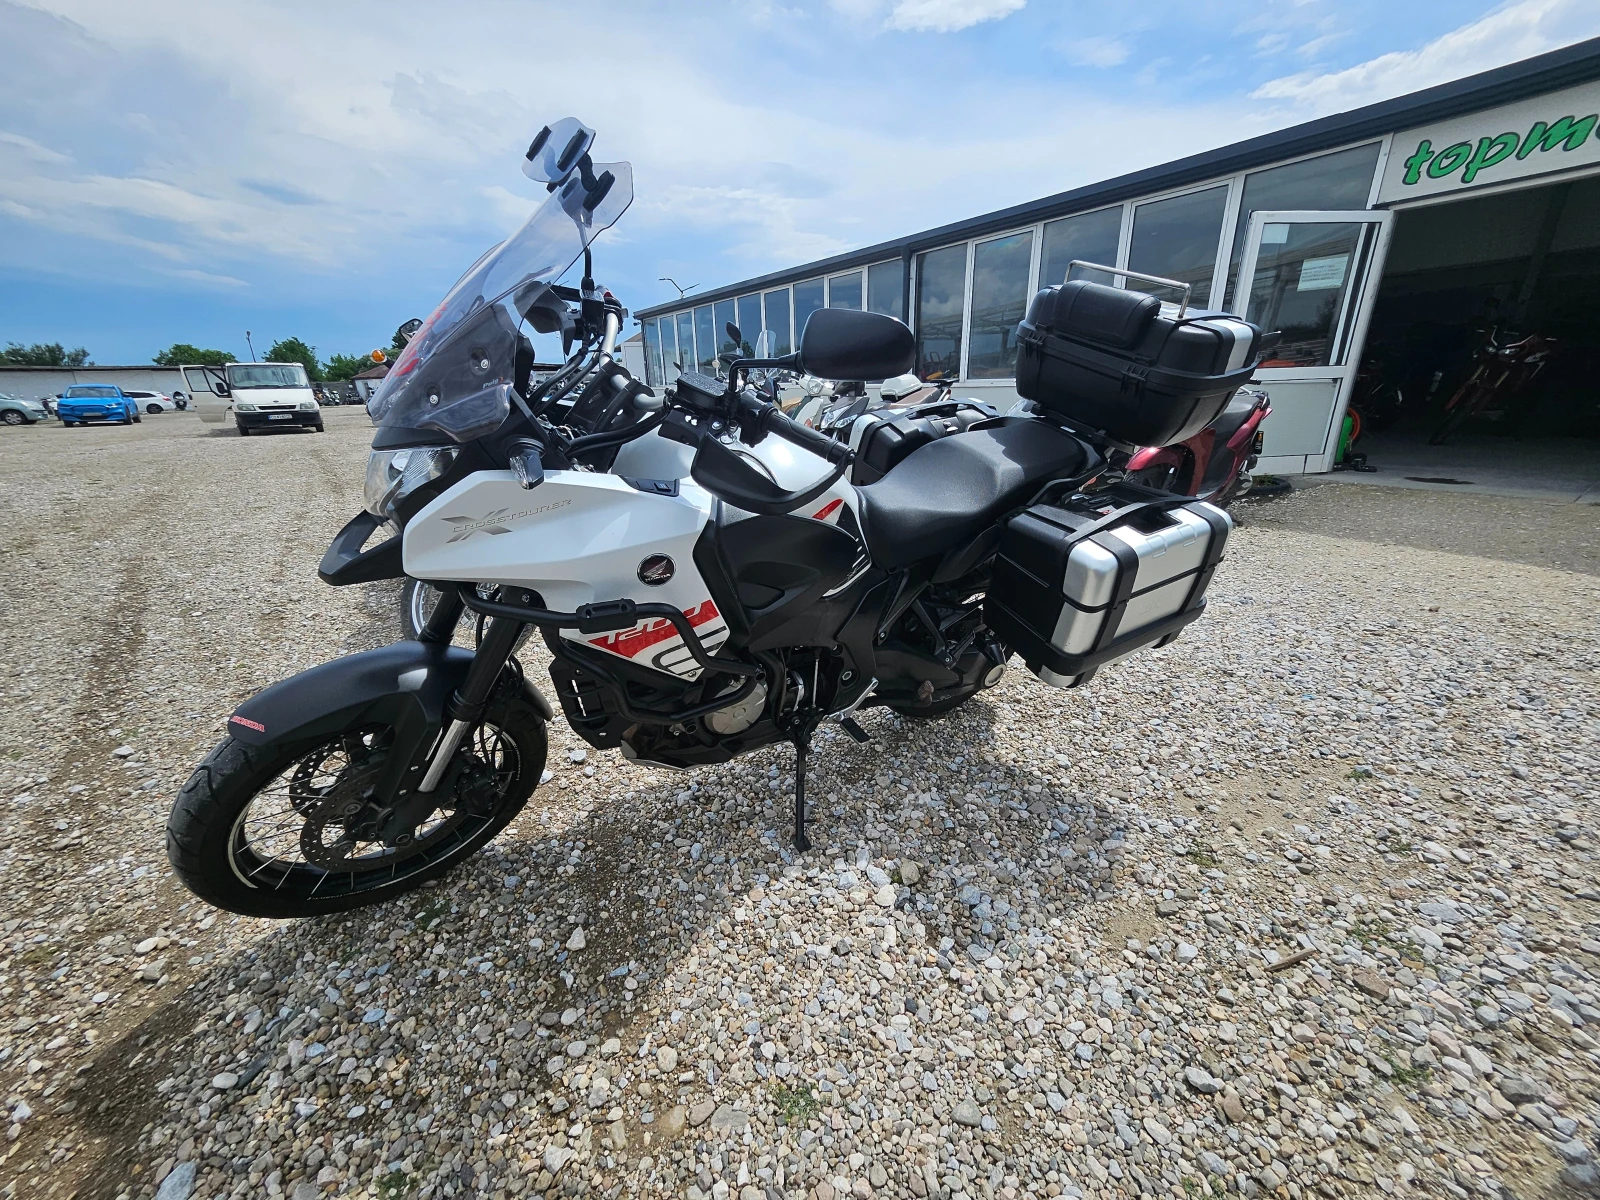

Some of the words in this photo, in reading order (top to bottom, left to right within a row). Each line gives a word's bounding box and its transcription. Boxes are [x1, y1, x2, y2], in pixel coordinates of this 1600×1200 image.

[1402, 114, 1600, 186] topm
[453, 499, 572, 533] CROSSTOURER
[230, 715, 265, 732] HONDA
